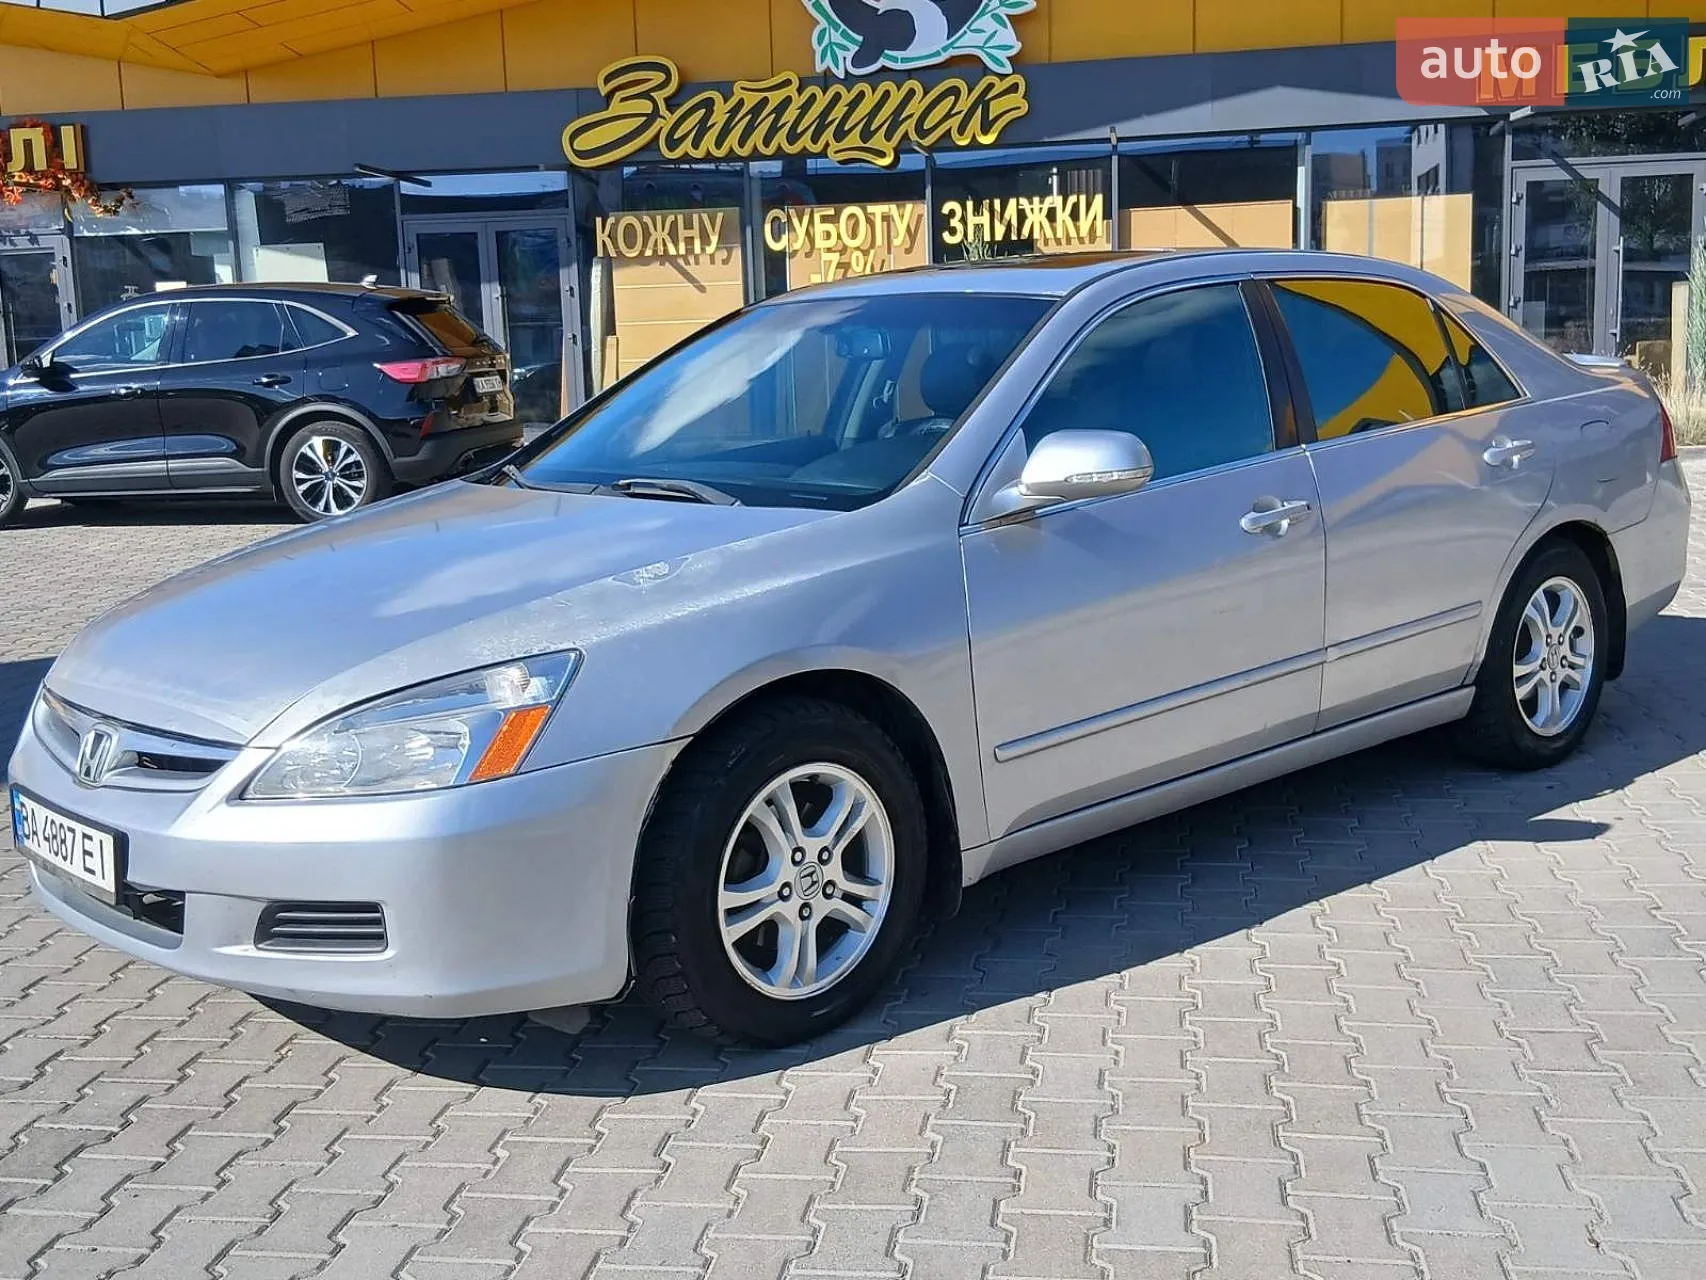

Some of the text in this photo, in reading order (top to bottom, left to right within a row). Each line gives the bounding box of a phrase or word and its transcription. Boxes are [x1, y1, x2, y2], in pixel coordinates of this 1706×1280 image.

[562, 55, 1029, 168] Затишок
[595, 194, 1104, 258] КОЖНУ СУБОТУ ЗНИЖКИ
[19, 801, 106, 881] BA 4887 EI
